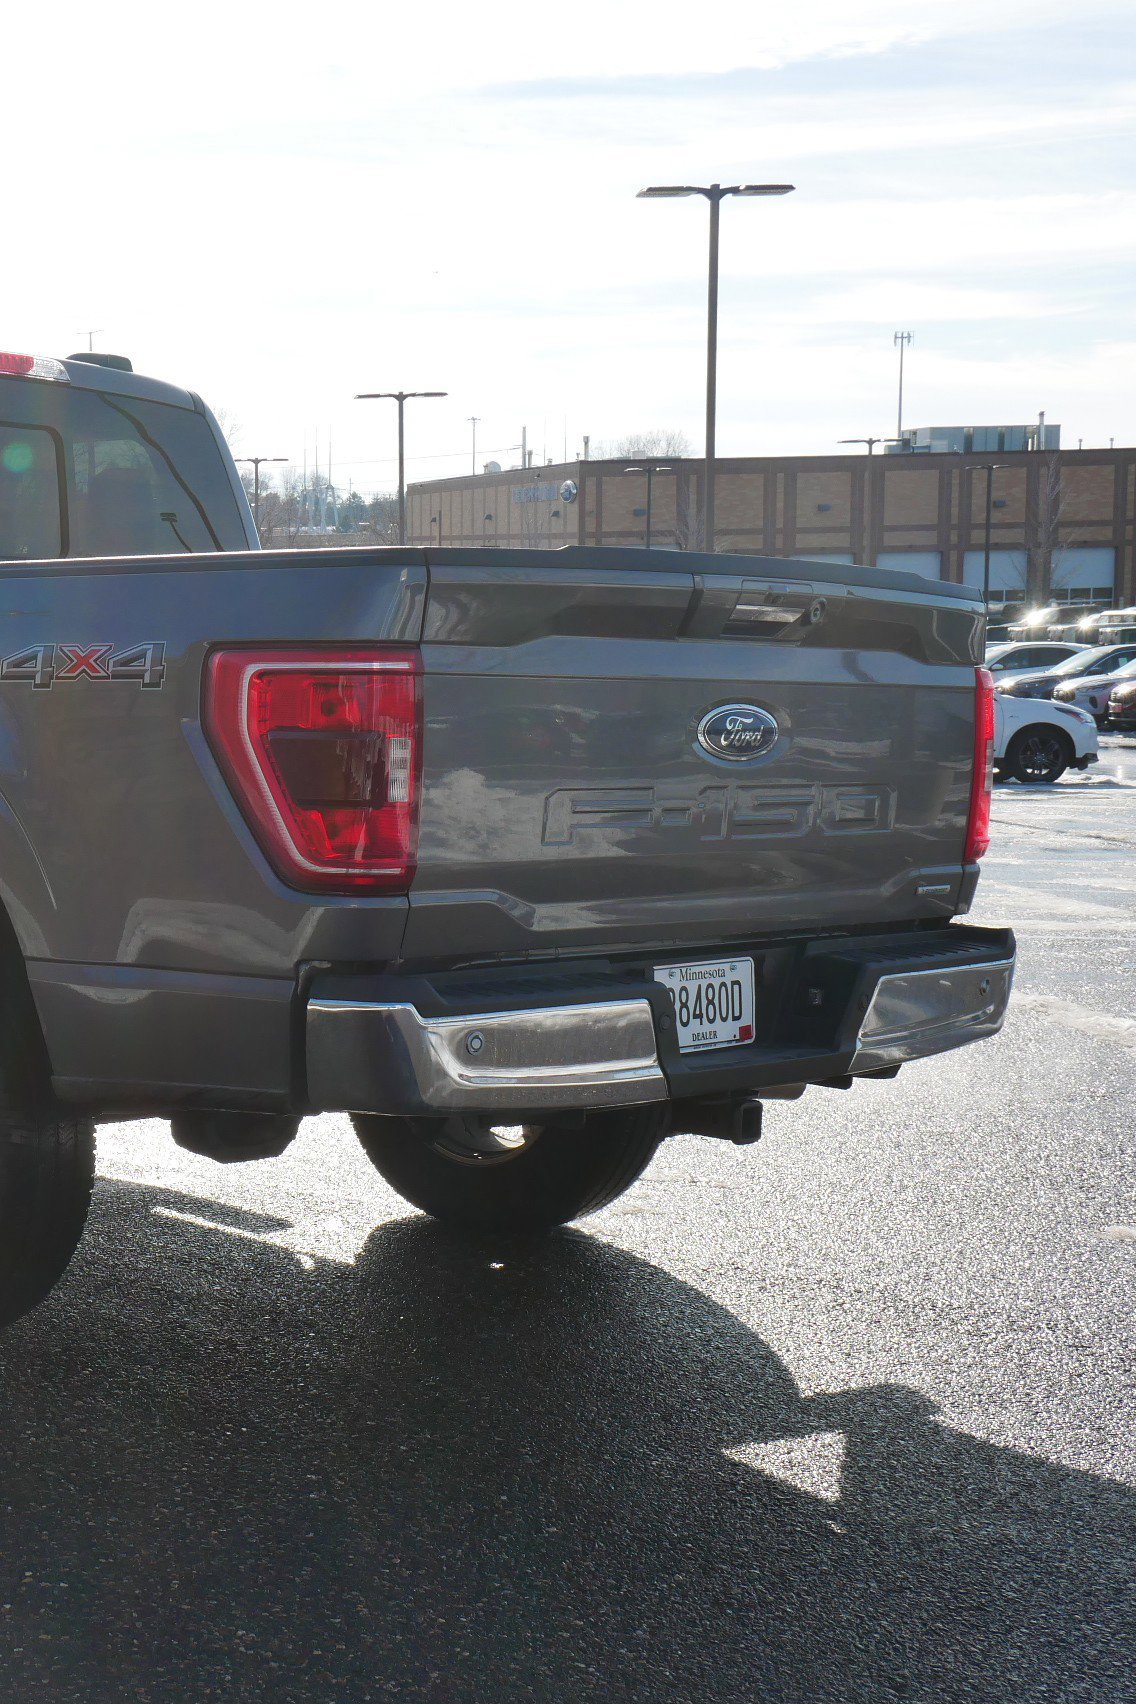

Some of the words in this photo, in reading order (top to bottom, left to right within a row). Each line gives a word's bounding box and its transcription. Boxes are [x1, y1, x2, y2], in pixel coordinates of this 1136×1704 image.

[720, 715, 764, 748] Ford
[541, 781, 898, 846] F-150
[679, 967, 726, 981] Minnesota
[667, 980, 743, 1027] 8480D
[691, 1030, 718, 1042] DEALER
